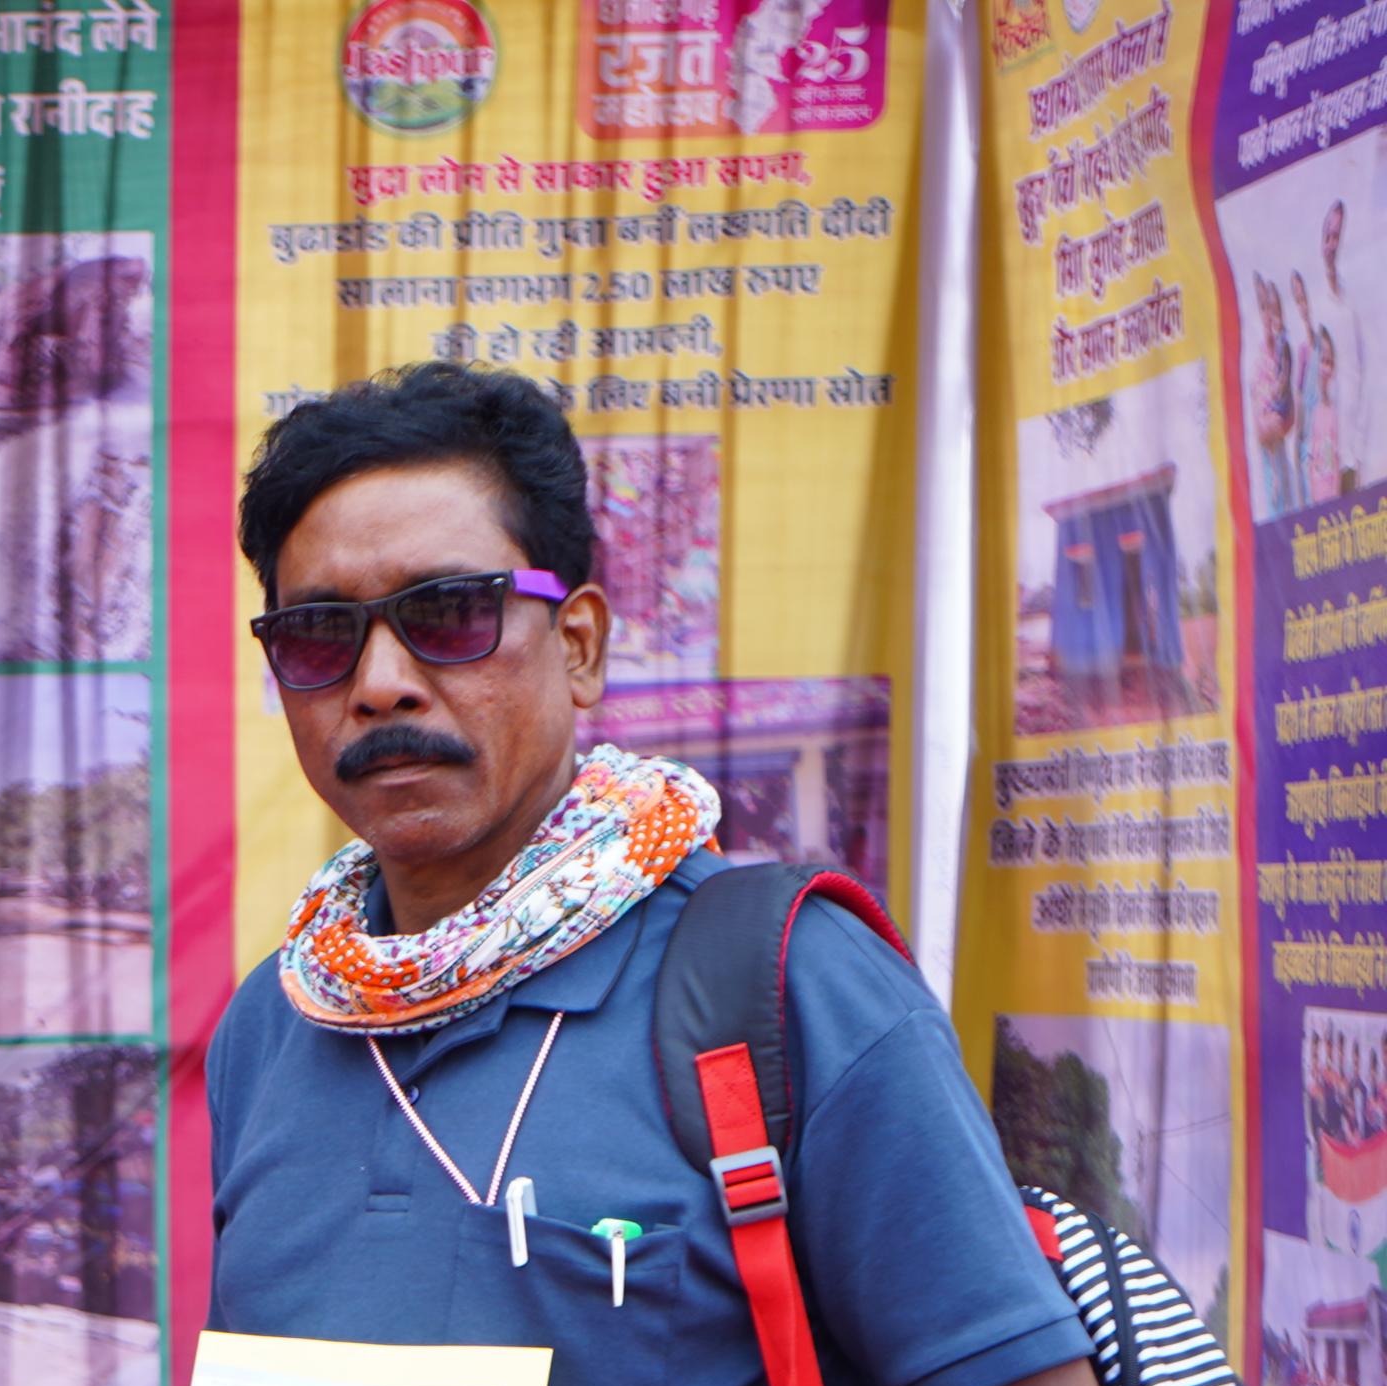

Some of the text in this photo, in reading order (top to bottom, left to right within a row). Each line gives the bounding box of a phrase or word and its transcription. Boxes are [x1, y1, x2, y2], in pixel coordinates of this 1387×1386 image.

[90, 0, 160, 53] लेने
[344, 40, 495, 87] Jashpur
[593, 30, 723, 88] रजत
[795, 25, 871, 84] 25
[10, 80, 158, 140] रानीदाह
[591, 85, 721, 129] महोत्सव
[346, 151, 813, 207] मुद्रा लोन से साकार हुआ सपना,
[395, 196, 895, 257] की प्रीति गुप्ता लखपति दीदी
[337, 264, 821, 307] सालाना लगभग 2.50 लाख रुपए
[430, 315, 723, 363] की हो रही आमदनी,
[588, 368, 818, 412] लिए बनी प्रेरणा
